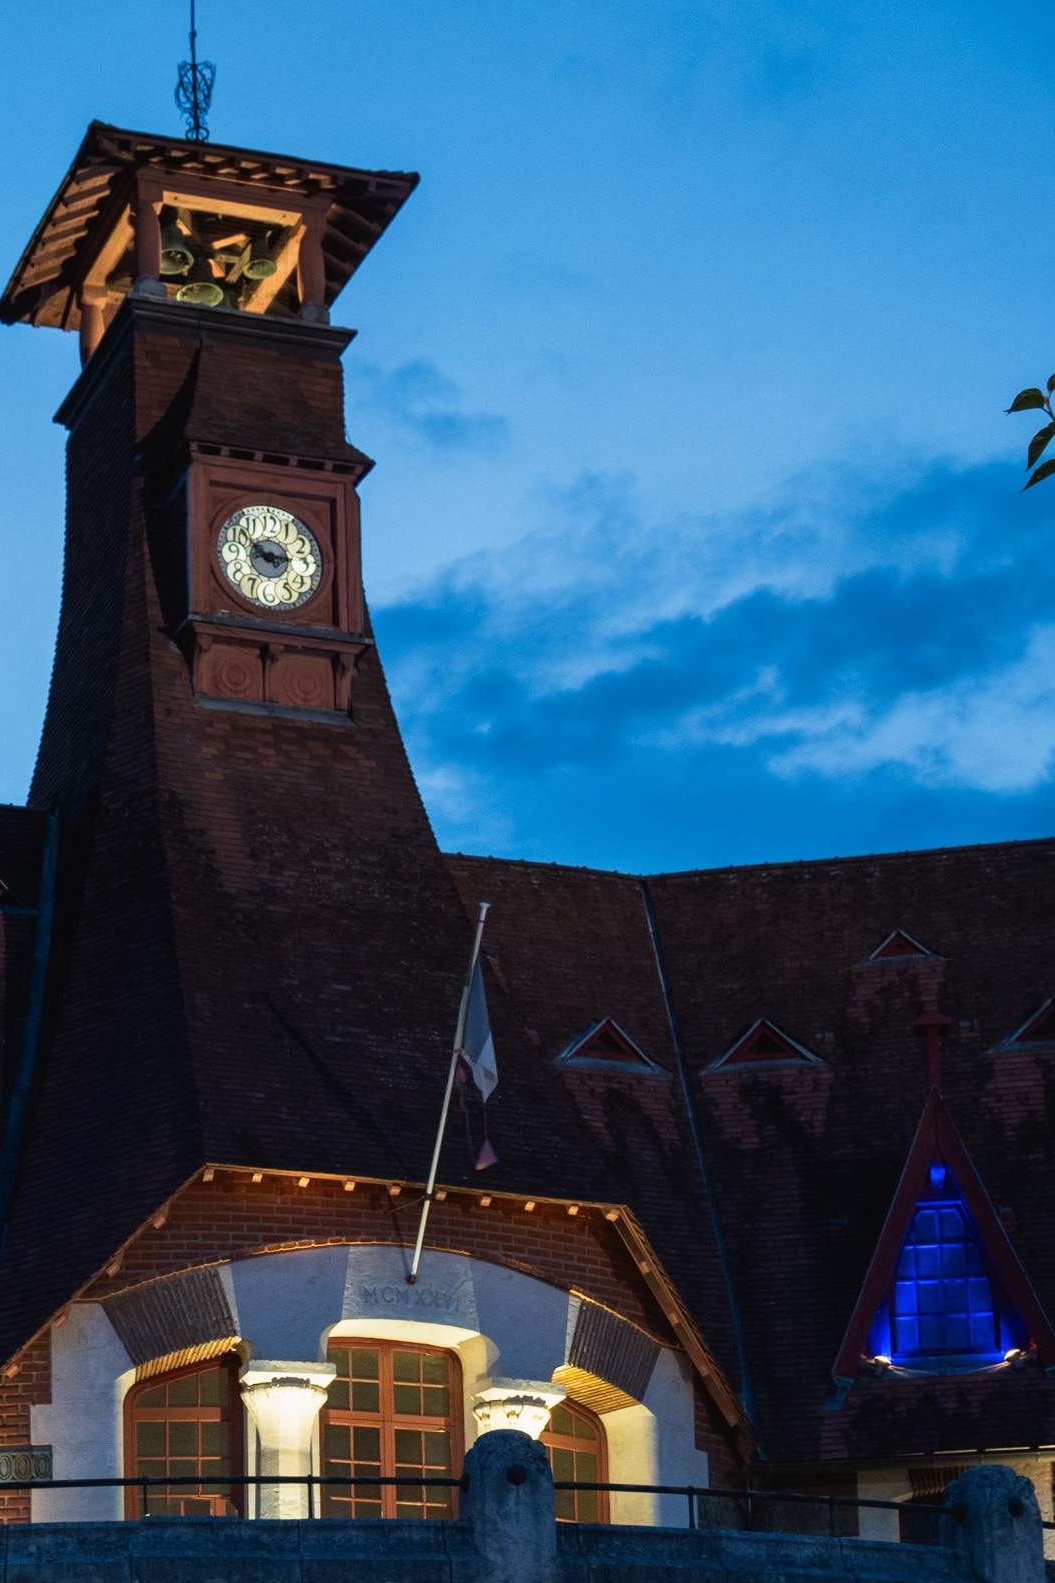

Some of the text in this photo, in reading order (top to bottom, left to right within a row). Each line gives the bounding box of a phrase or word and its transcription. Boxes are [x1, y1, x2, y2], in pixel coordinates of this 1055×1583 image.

[246, 517, 256, 534] 11
[264, 515, 276, 533] 12
[228, 543, 240, 559] 9
[296, 537, 306, 555] 2
[233, 562, 242, 582] 8
[299, 558, 310, 573] 3
[247, 577, 256, 596] 7
[281, 582, 293, 601] 5
[292, 575, 307, 590] 4
[262, 582, 275, 603] 6
